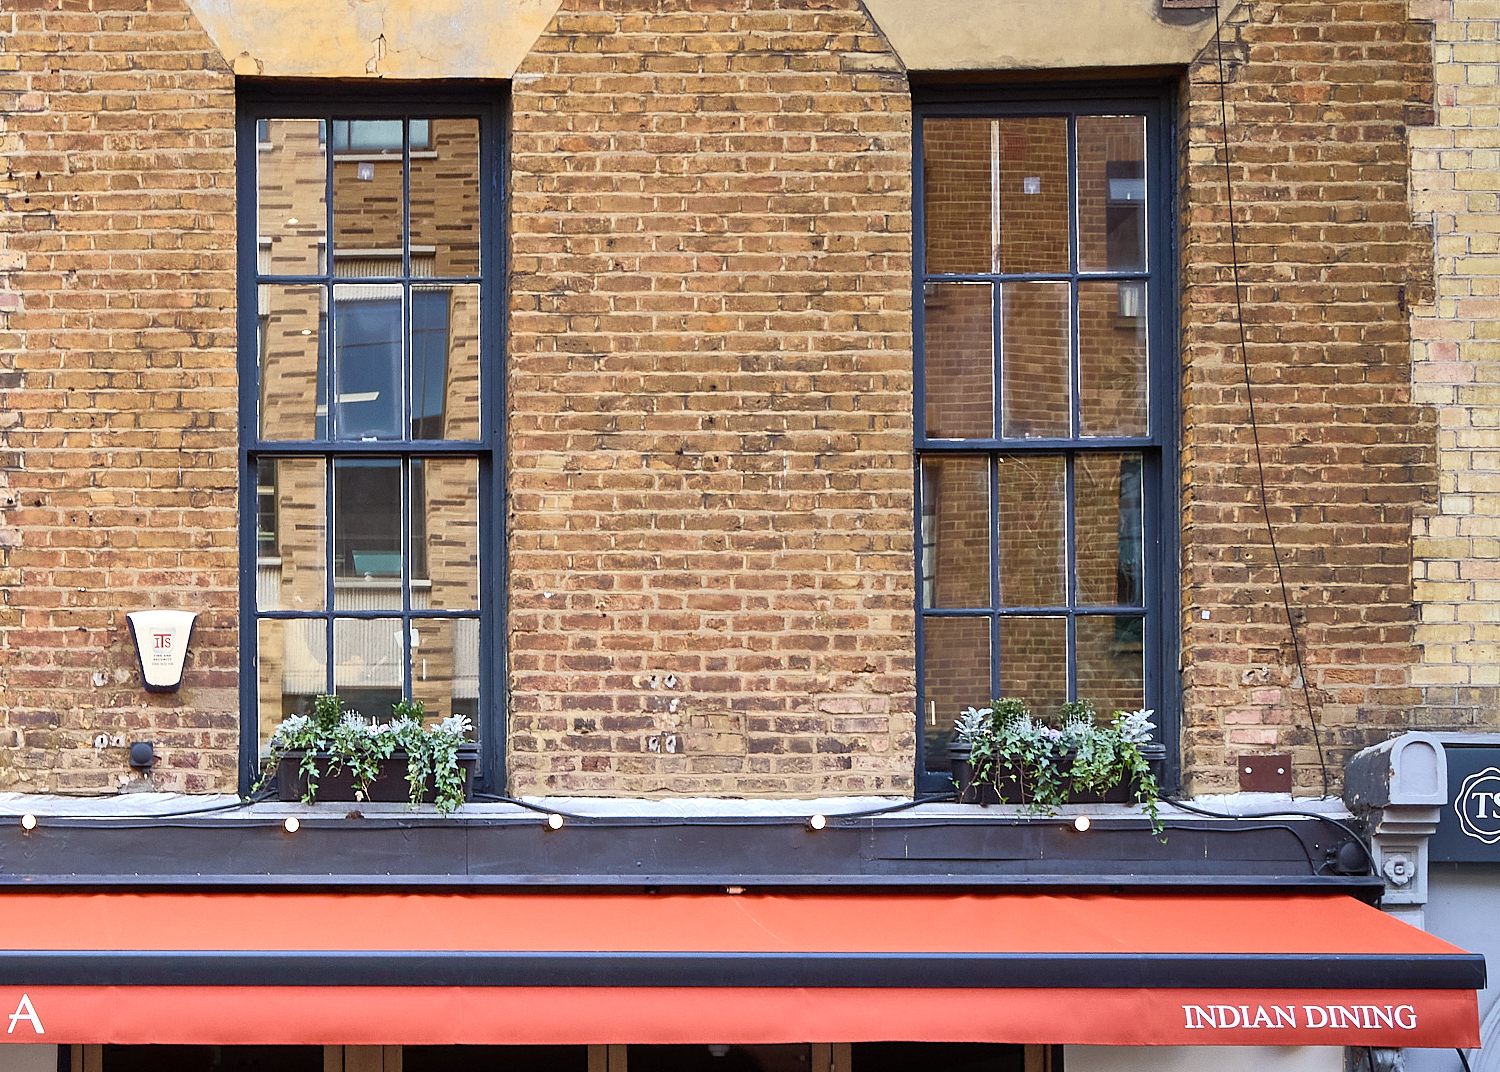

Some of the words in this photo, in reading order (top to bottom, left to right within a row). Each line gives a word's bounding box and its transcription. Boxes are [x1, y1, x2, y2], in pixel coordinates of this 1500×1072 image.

[153, 633, 172, 649] ITS
[1182, 1005, 1297, 1029] INDIAN
[1302, 1005, 1418, 1030] DINING
